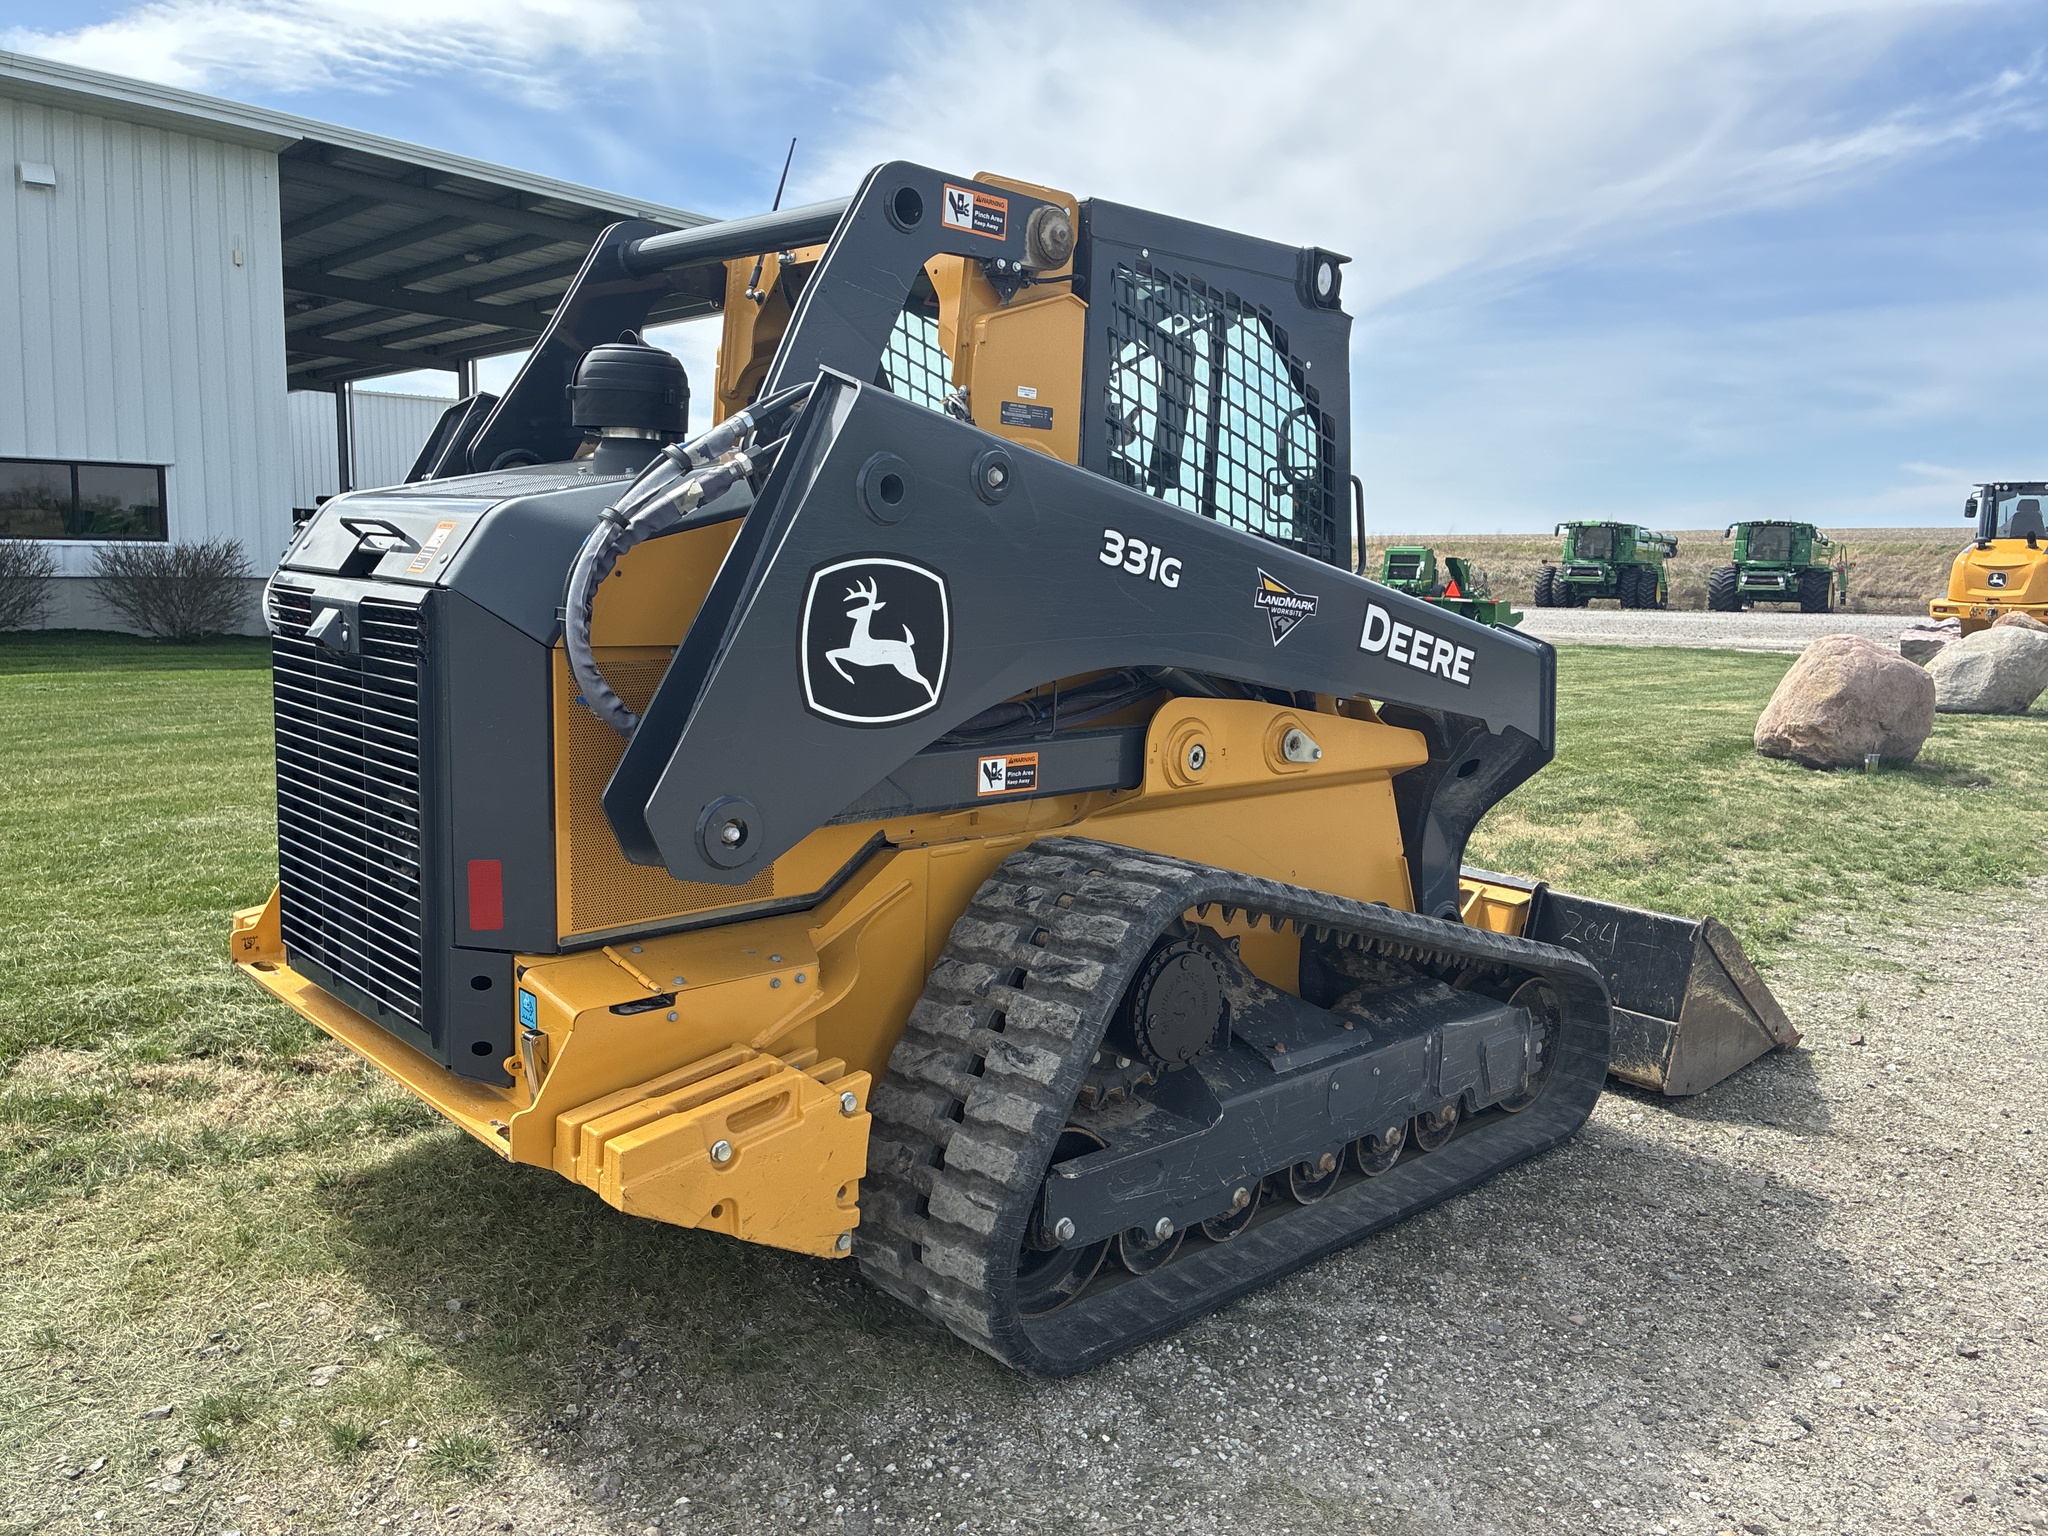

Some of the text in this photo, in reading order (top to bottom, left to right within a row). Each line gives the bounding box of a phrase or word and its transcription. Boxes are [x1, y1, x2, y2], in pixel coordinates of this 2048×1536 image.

[981, 198, 1005, 208] WARNING
[974, 210, 1004, 224] Pinch Area
[974, 219, 999, 231] Keep Away
[1099, 529, 1182, 588] 331G
[1257, 592, 1315, 611] LANDMARK
[1270, 607, 1303, 617] WORKSITE
[1360, 603, 1475, 685] DEERE
